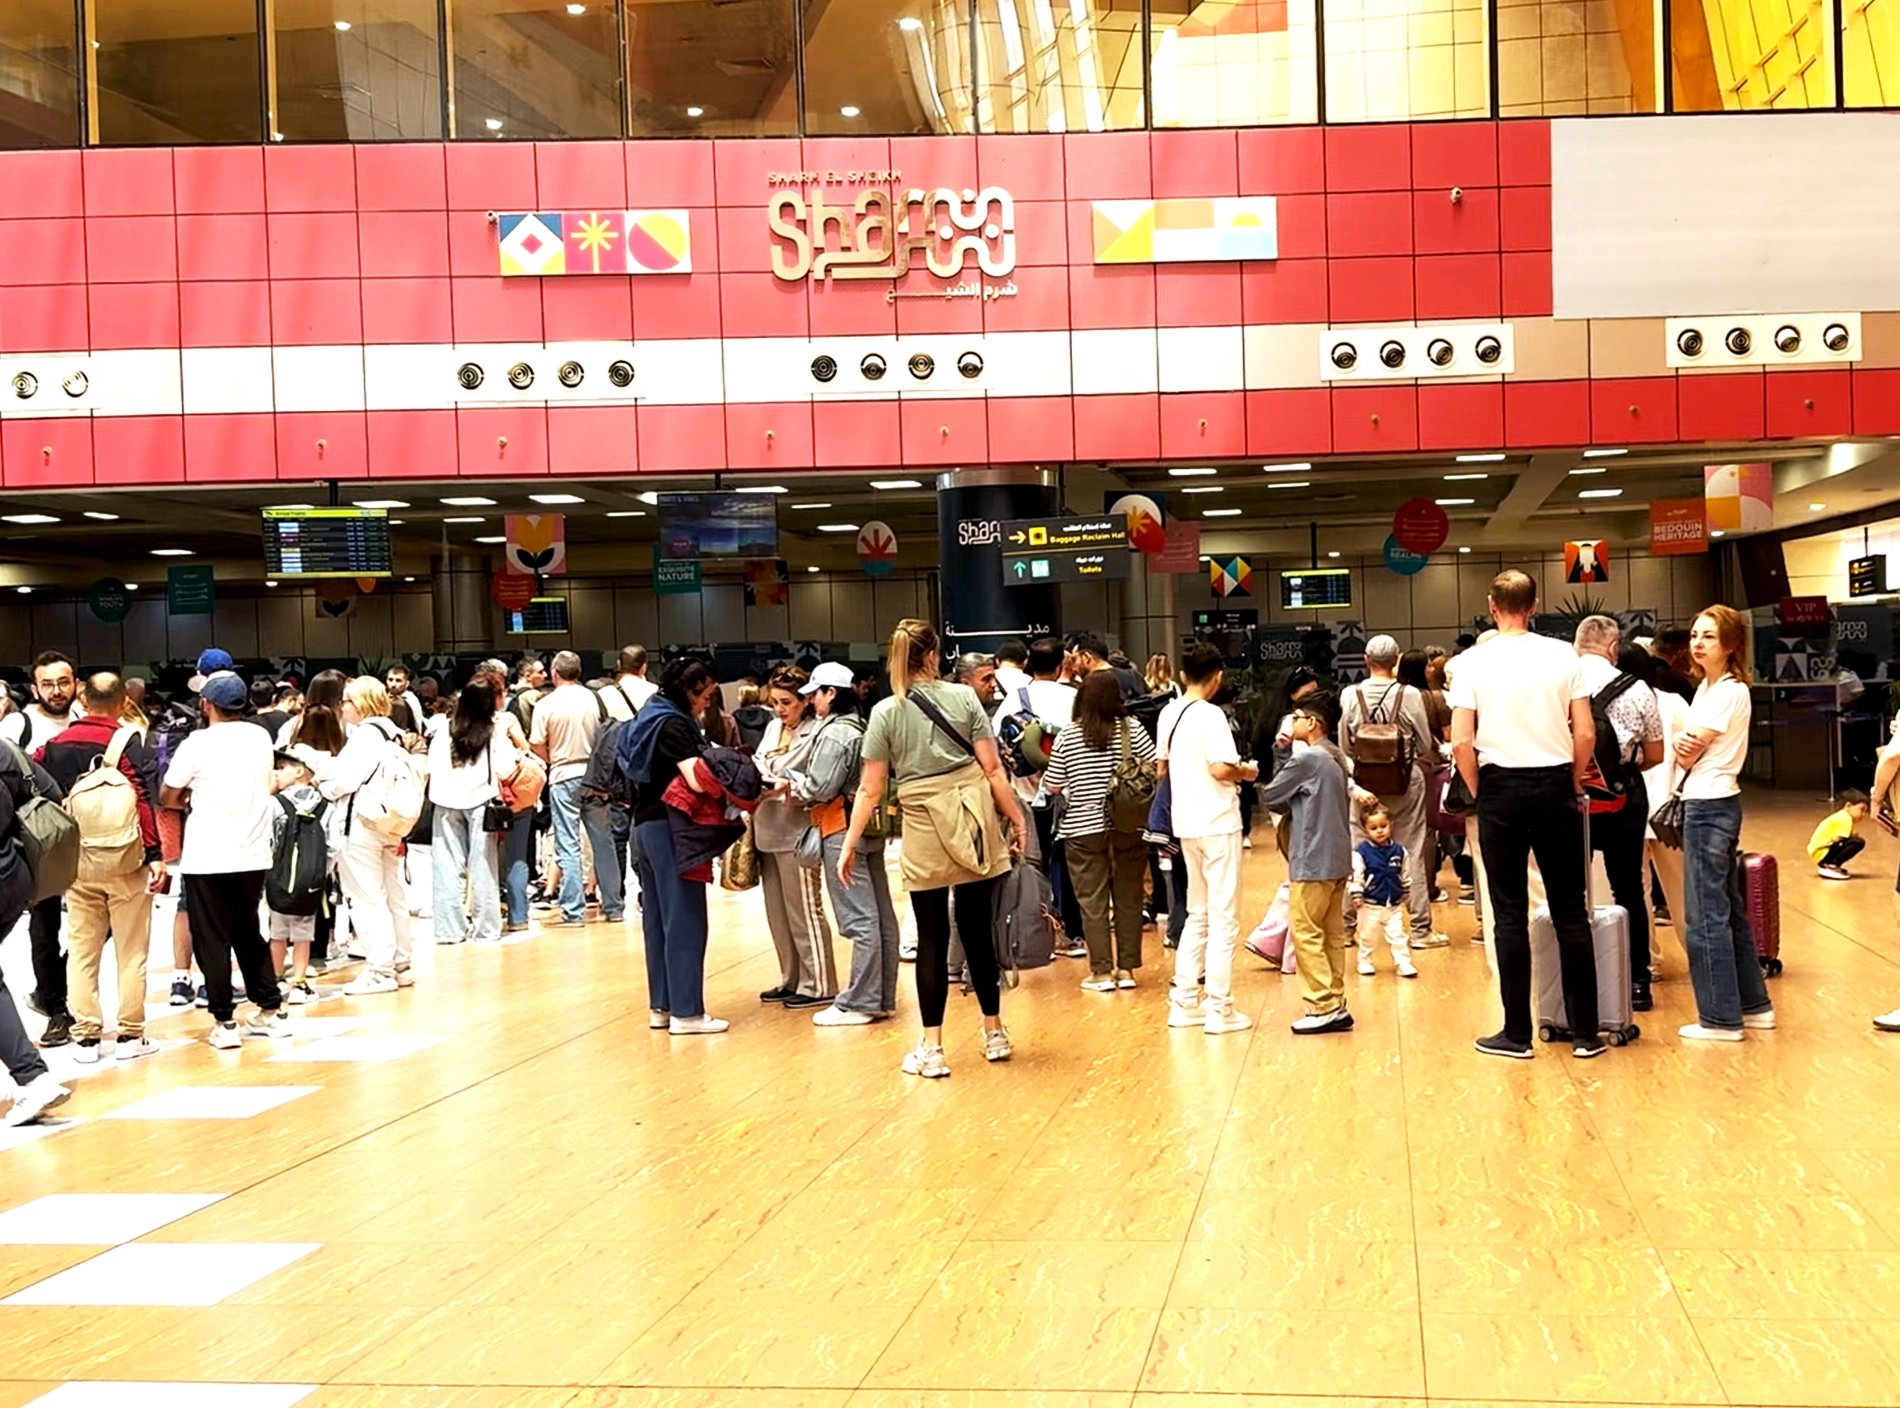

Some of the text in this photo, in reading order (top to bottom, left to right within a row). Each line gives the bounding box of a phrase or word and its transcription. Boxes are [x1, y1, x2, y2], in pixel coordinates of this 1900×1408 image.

[768, 171, 820, 184] SHARM
[826, 170, 843, 184] EL
[983, 280, 1018, 300] شرم
[958, 520, 1001, 546] Shar
[1653, 522, 1702, 534] BEDOUIN
[1050, 535, 1081, 544] Baggage
[1082, 532, 1110, 540] Reclaim
[1653, 531, 1703, 542] HERITAGE
[1079, 566, 1102, 574] Toilets
[658, 572, 696, 581] NATURE
[1795, 603, 1817, 612] VIP
[945, 621, 1050, 638] مدينة
